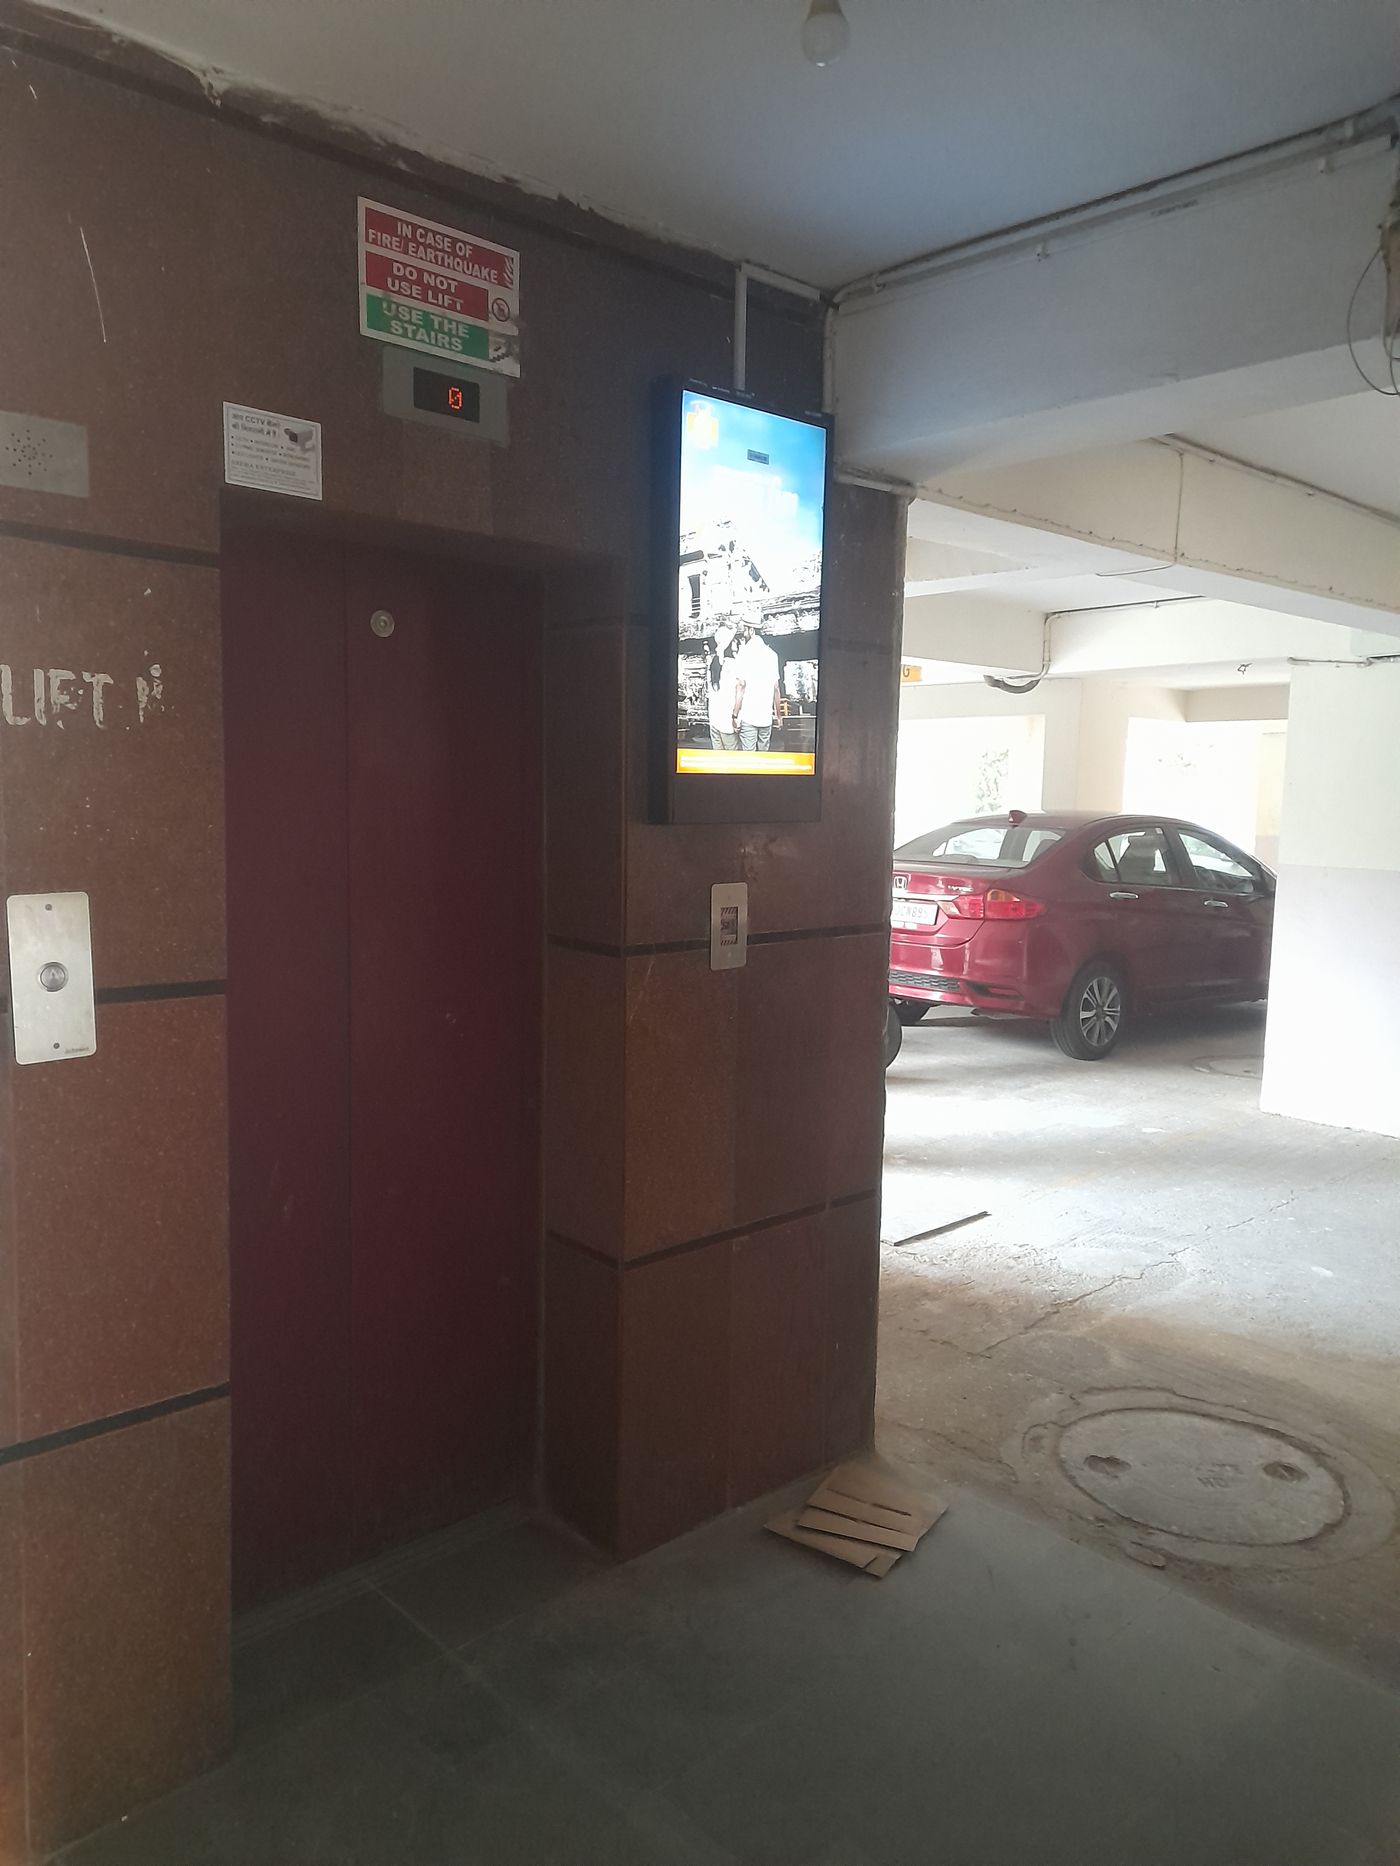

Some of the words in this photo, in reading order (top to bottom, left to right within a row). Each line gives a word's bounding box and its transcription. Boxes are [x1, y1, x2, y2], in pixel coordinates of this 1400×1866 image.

[397, 221, 412, 239] IN
[416, 228, 452, 252] CASE
[456, 242, 473, 258] OF
[392, 262, 418, 280] DO
[423, 271, 458, 293] NOT
[408, 242, 498, 284] EARTHQUAKE
[387, 277, 422, 299] USE
[428, 289, 463, 311] LIFT
[382, 301, 423, 325] USE
[430, 314, 470, 339] THE
[391, 320, 463, 351] STAIRS
[245, 415, 266, 425] CCTV
[0, 664, 114, 729] LIFT
